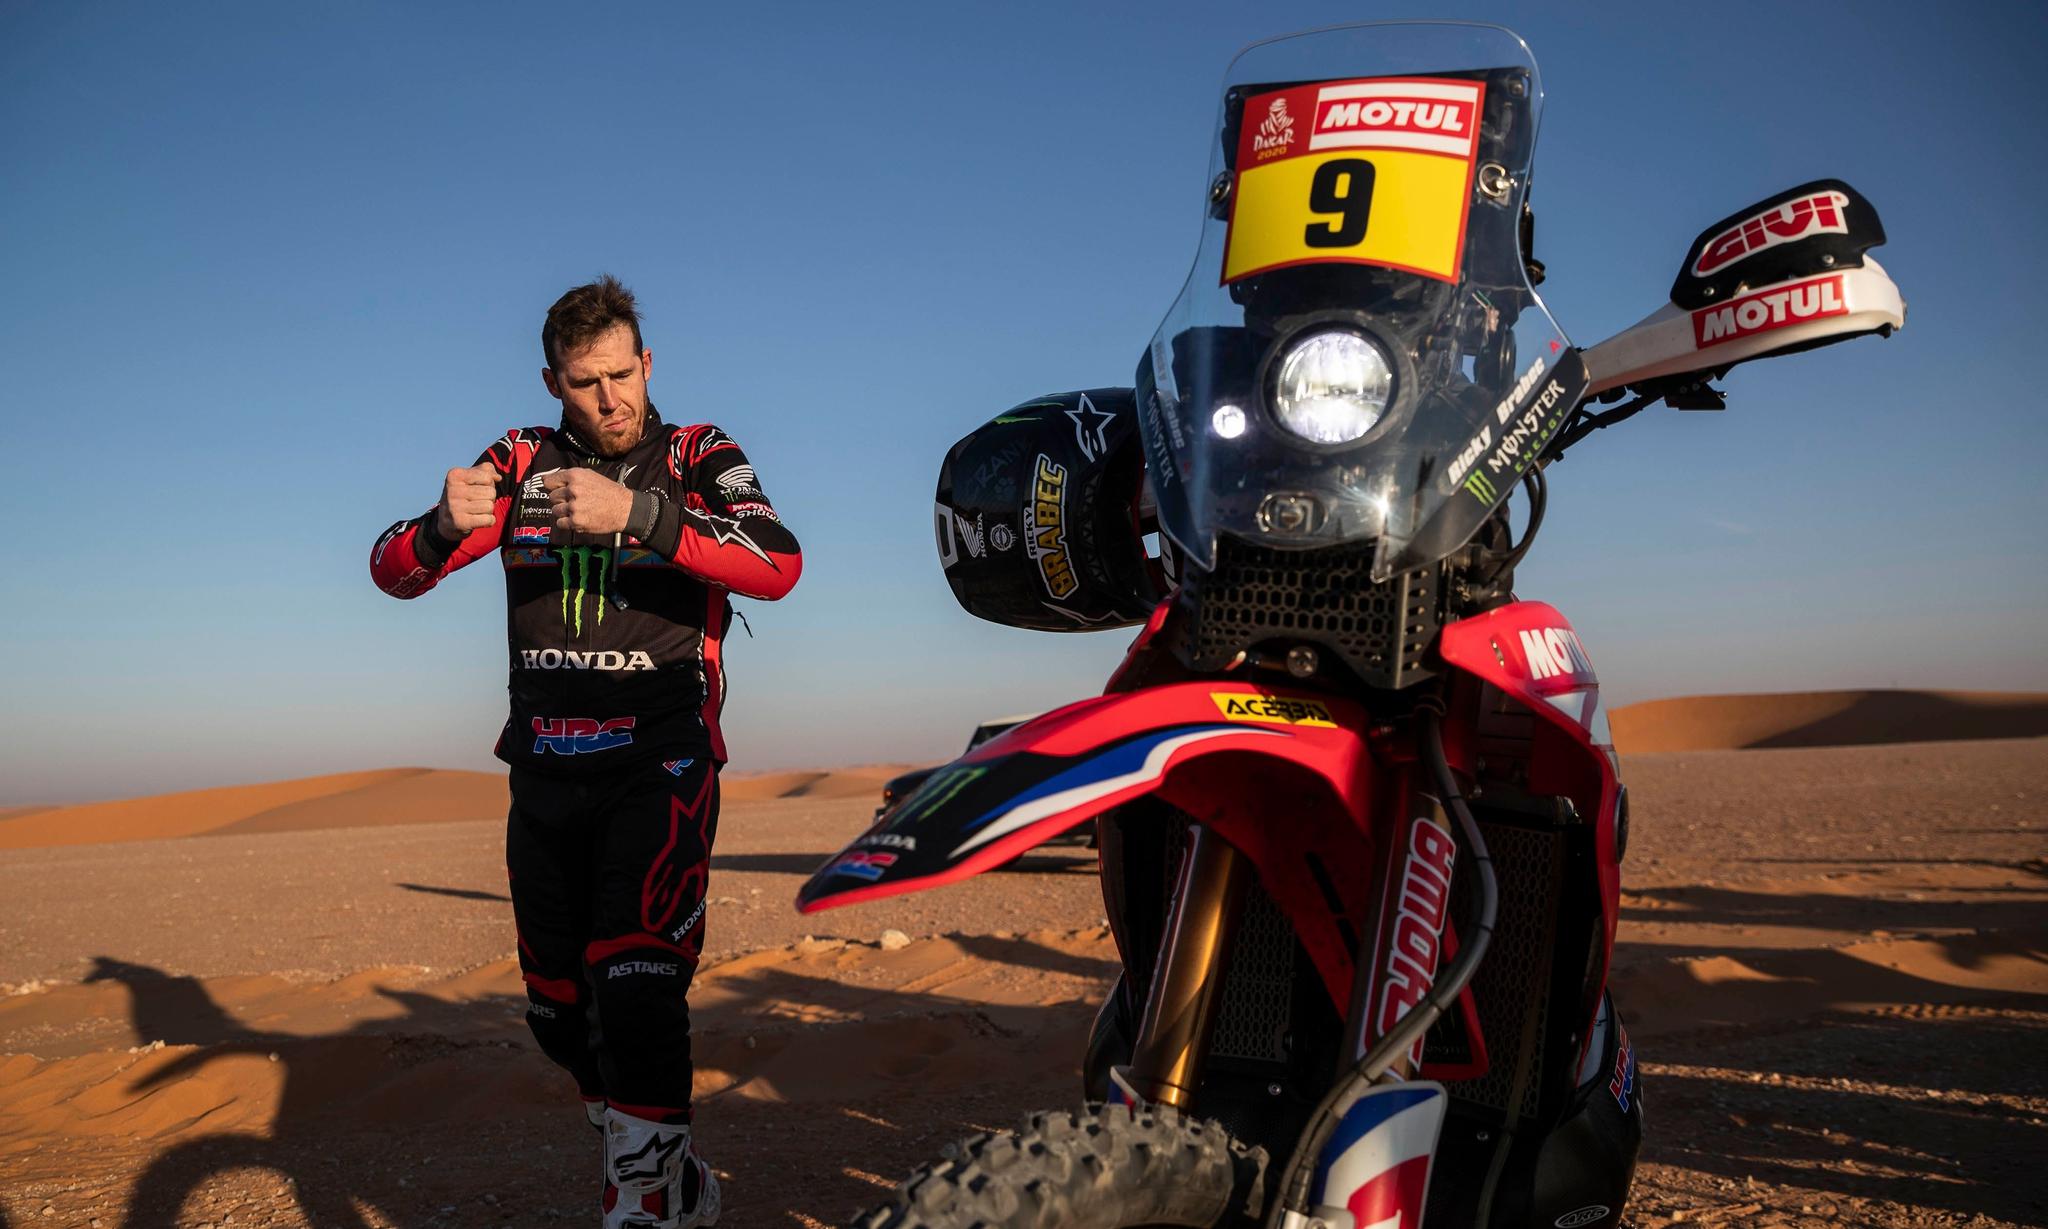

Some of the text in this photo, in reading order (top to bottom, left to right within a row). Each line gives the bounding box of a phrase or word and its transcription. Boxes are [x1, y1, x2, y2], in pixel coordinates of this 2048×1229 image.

[1321, 101, 1464, 131] MOTUL
[1253, 128, 1295, 151] DAKAR
[1257, 146, 1287, 160] 2020
[1304, 158, 1376, 248] 9
[1697, 195, 1840, 273] GIVI
[1702, 282, 1846, 342] MOTUL
[1488, 379, 1566, 473] MONSTER
[1513, 408, 1564, 473] ENERGY
[513, 526, 552, 545] HRC
[976, 512, 988, 558] HONDA
[1024, 508, 1037, 557] RICKY
[1033, 454, 1078, 599] BRABEC
[520, 649, 658, 672] HONDA
[532, 716, 637, 756] HRC
[834, 850, 901, 883] RC
[608, 961, 678, 980] ASTARS
